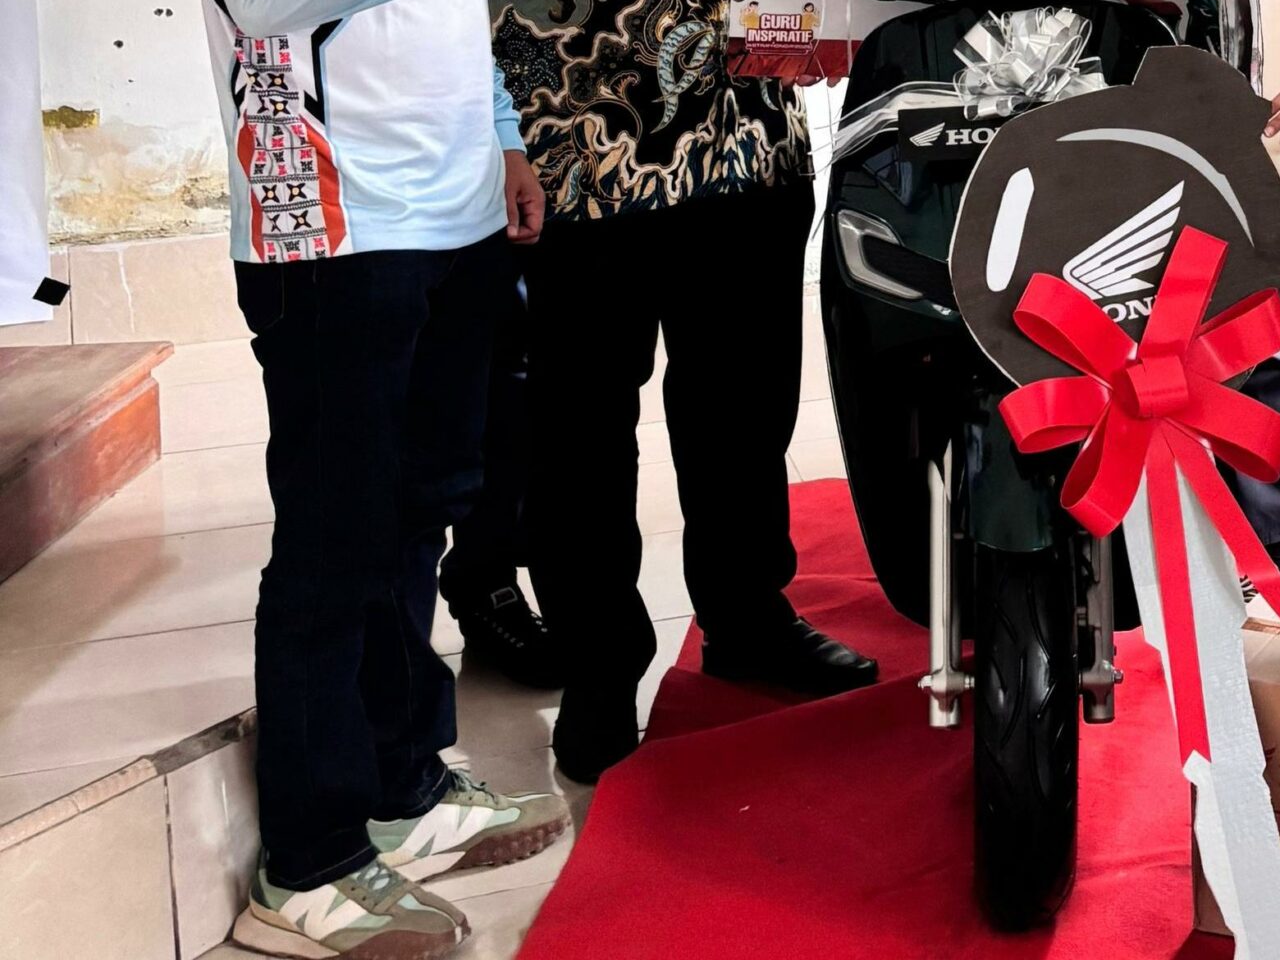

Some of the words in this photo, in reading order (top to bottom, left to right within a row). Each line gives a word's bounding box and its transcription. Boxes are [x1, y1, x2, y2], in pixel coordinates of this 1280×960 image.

[761, 14, 801, 30] GURU
[747, 29, 812, 43] INSPIRATIF
[945, 126, 1000, 146] HO
[1101, 295, 1157, 323] ON
